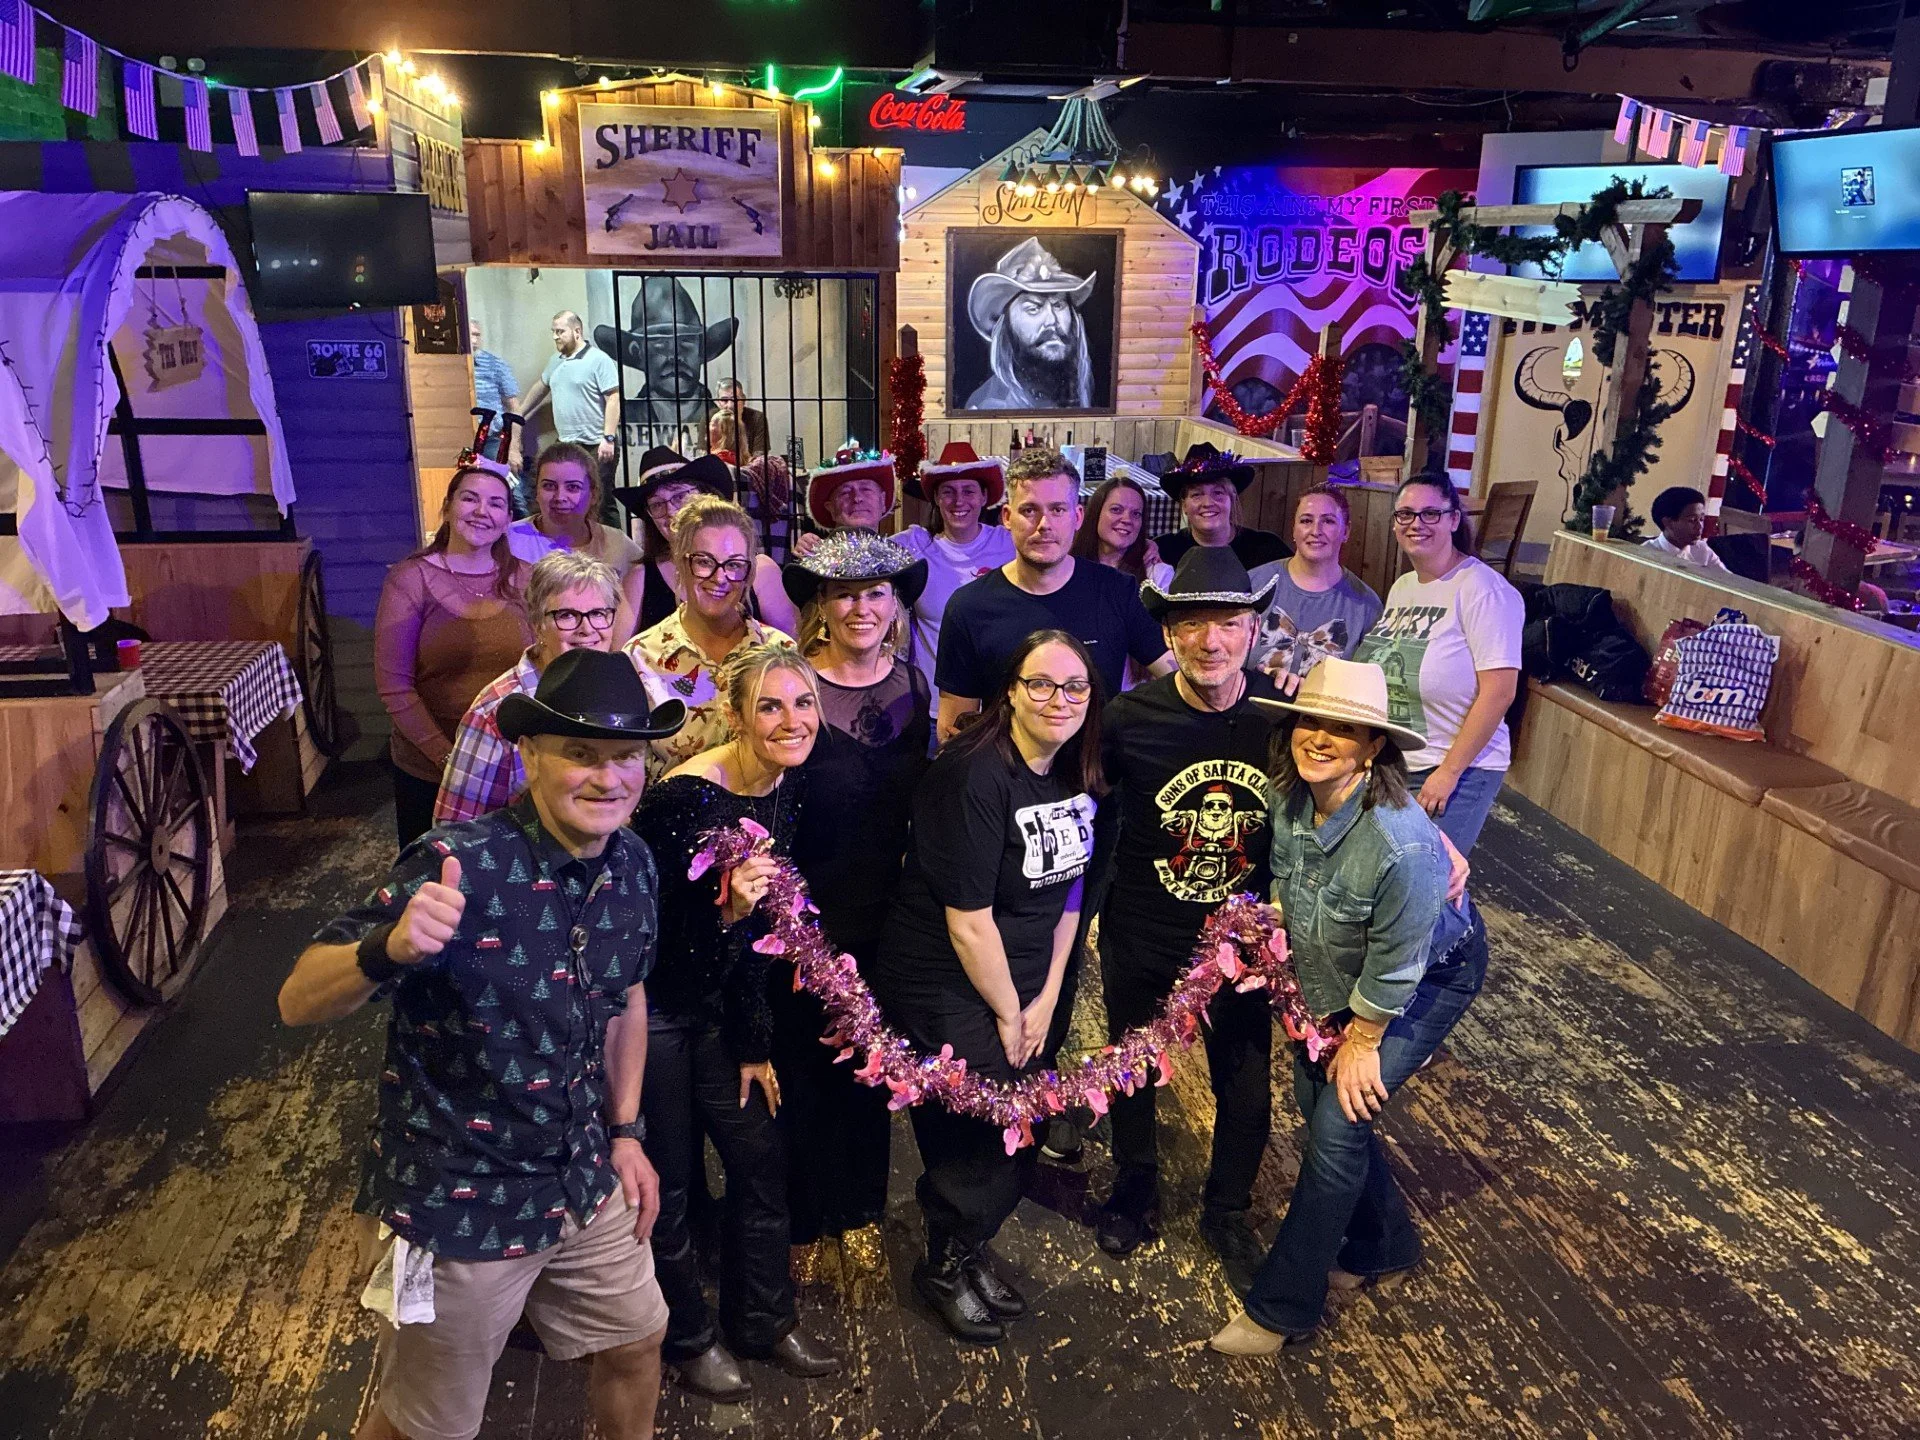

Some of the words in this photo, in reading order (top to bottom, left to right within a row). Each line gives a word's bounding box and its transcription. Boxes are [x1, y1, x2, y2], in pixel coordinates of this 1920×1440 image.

[595, 123, 761, 169] SHERIFF
[1201, 195, 1256, 216] THIS
[1327, 197, 1364, 216] MY
[1368, 196, 1437, 217] FIRST
[644, 224, 717, 250] JAIL
[1207, 224, 1427, 310] RODEOS
[1569, 301, 1725, 341] MTER
[311, 343, 361, 358] ROUTE
[364, 344, 383, 358] 66
[1370, 605, 1447, 639] LUCKY
[1160, 778, 1187, 806] SONS
[1185, 768, 1200, 785] OF
[1203, 763, 1244, 782] SANTA
[1247, 772, 1269, 803] CLAU
